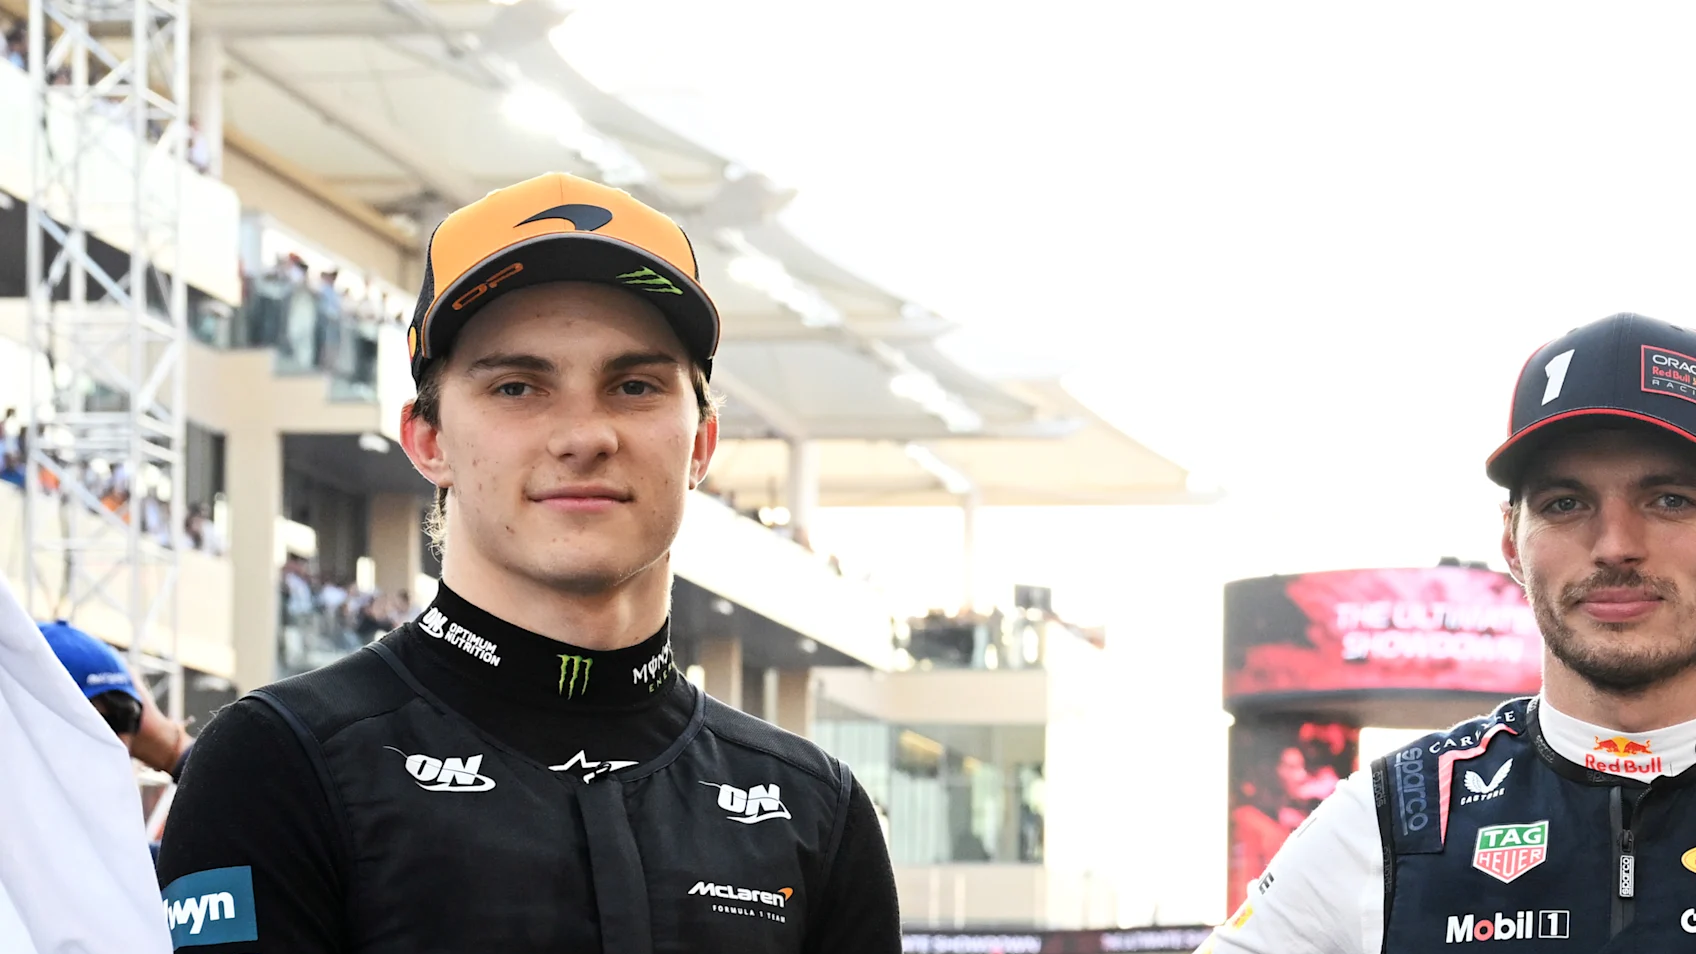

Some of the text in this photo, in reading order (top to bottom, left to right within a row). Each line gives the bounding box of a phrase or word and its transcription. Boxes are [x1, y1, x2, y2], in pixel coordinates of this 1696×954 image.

[1541, 349, 1576, 406] 1
[1652, 366, 1691, 384] Red Bull
[444, 632, 500, 667] NUTRITION
[449, 622, 497, 653] OPTIMUM
[405, 754, 494, 791] ON
[1585, 753, 1663, 773] Red Bull
[717, 784, 789, 822] ON
[1396, 747, 1429, 833] sparco
[1484, 826, 1543, 848] TAG
[1478, 847, 1545, 879] HEUER
[1621, 857, 1633, 896] sparco
[688, 881, 785, 907] McLaren
[161, 891, 235, 934] wyn
[712, 905, 755, 916] FORMULA
[767, 912, 786, 923] TEAM
[1445, 910, 1534, 943] Mobil
